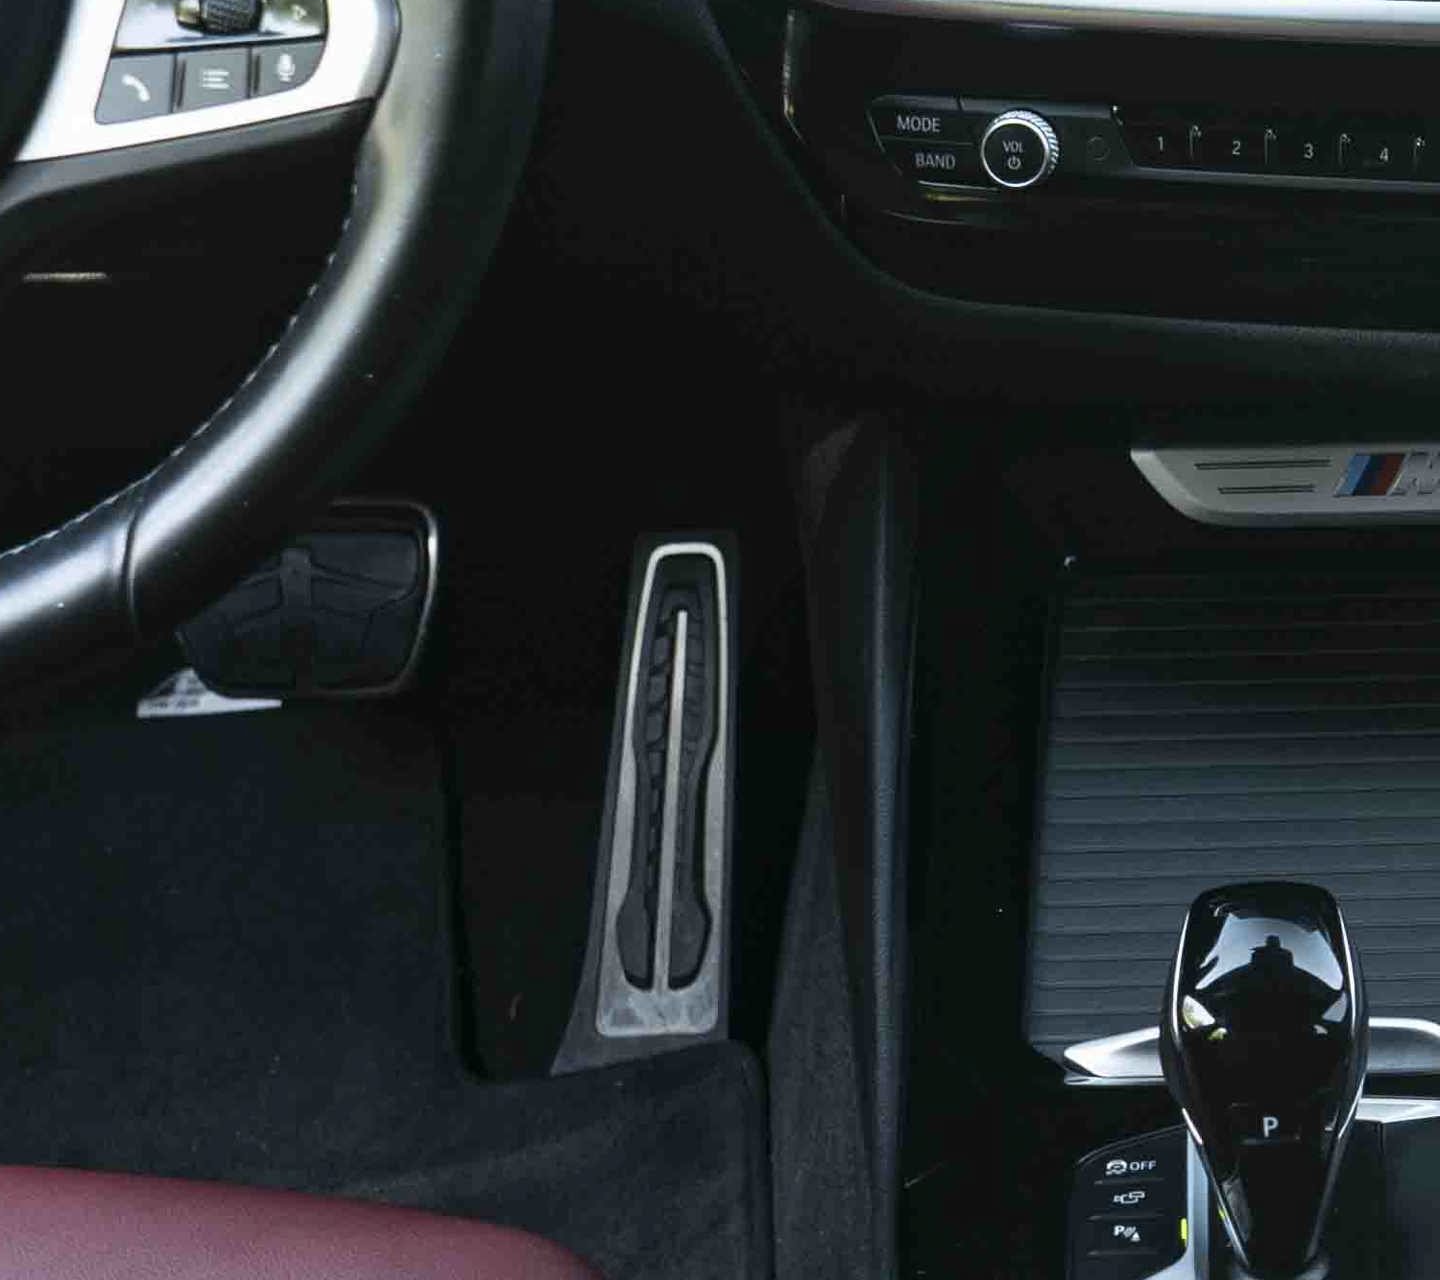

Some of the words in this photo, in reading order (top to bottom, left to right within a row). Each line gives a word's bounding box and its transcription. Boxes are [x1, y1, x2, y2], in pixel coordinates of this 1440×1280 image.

[896, 114, 941, 133] MODE
[1002, 140, 1024, 154] VOL
[1157, 135, 1164, 152] 1
[1232, 140, 1241, 155] 2
[1304, 143, 1313, 159] 3
[1379, 147, 1389, 162] 4
[915, 152, 956, 169] BAND
[1263, 1117, 1279, 1138] P
[1130, 1160, 1156, 1171] OFF
